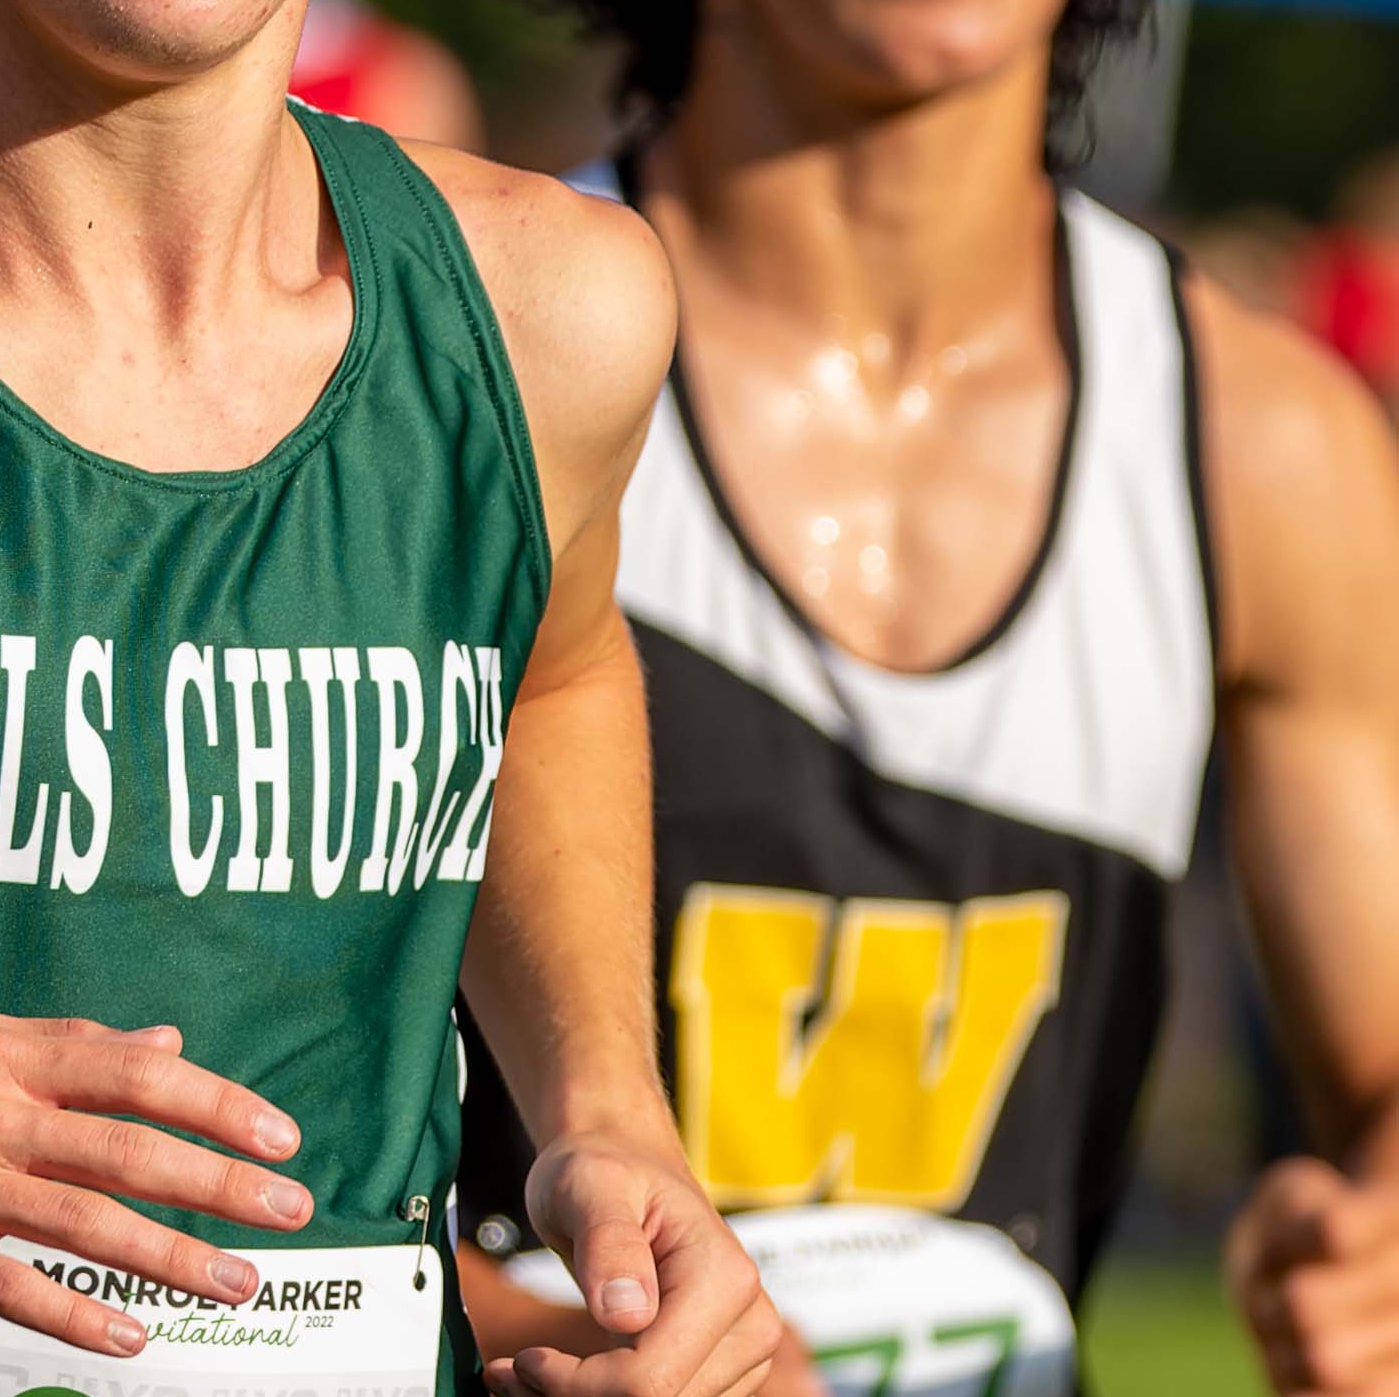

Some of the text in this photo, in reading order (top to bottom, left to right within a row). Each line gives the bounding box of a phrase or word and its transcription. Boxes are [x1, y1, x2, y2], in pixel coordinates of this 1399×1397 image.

[165, 640, 505, 898] CHURCH
[671, 882, 1069, 1211] W
[230, 1279, 363, 1312] ARKER
[304, 1315, 334, 1329] 2022
